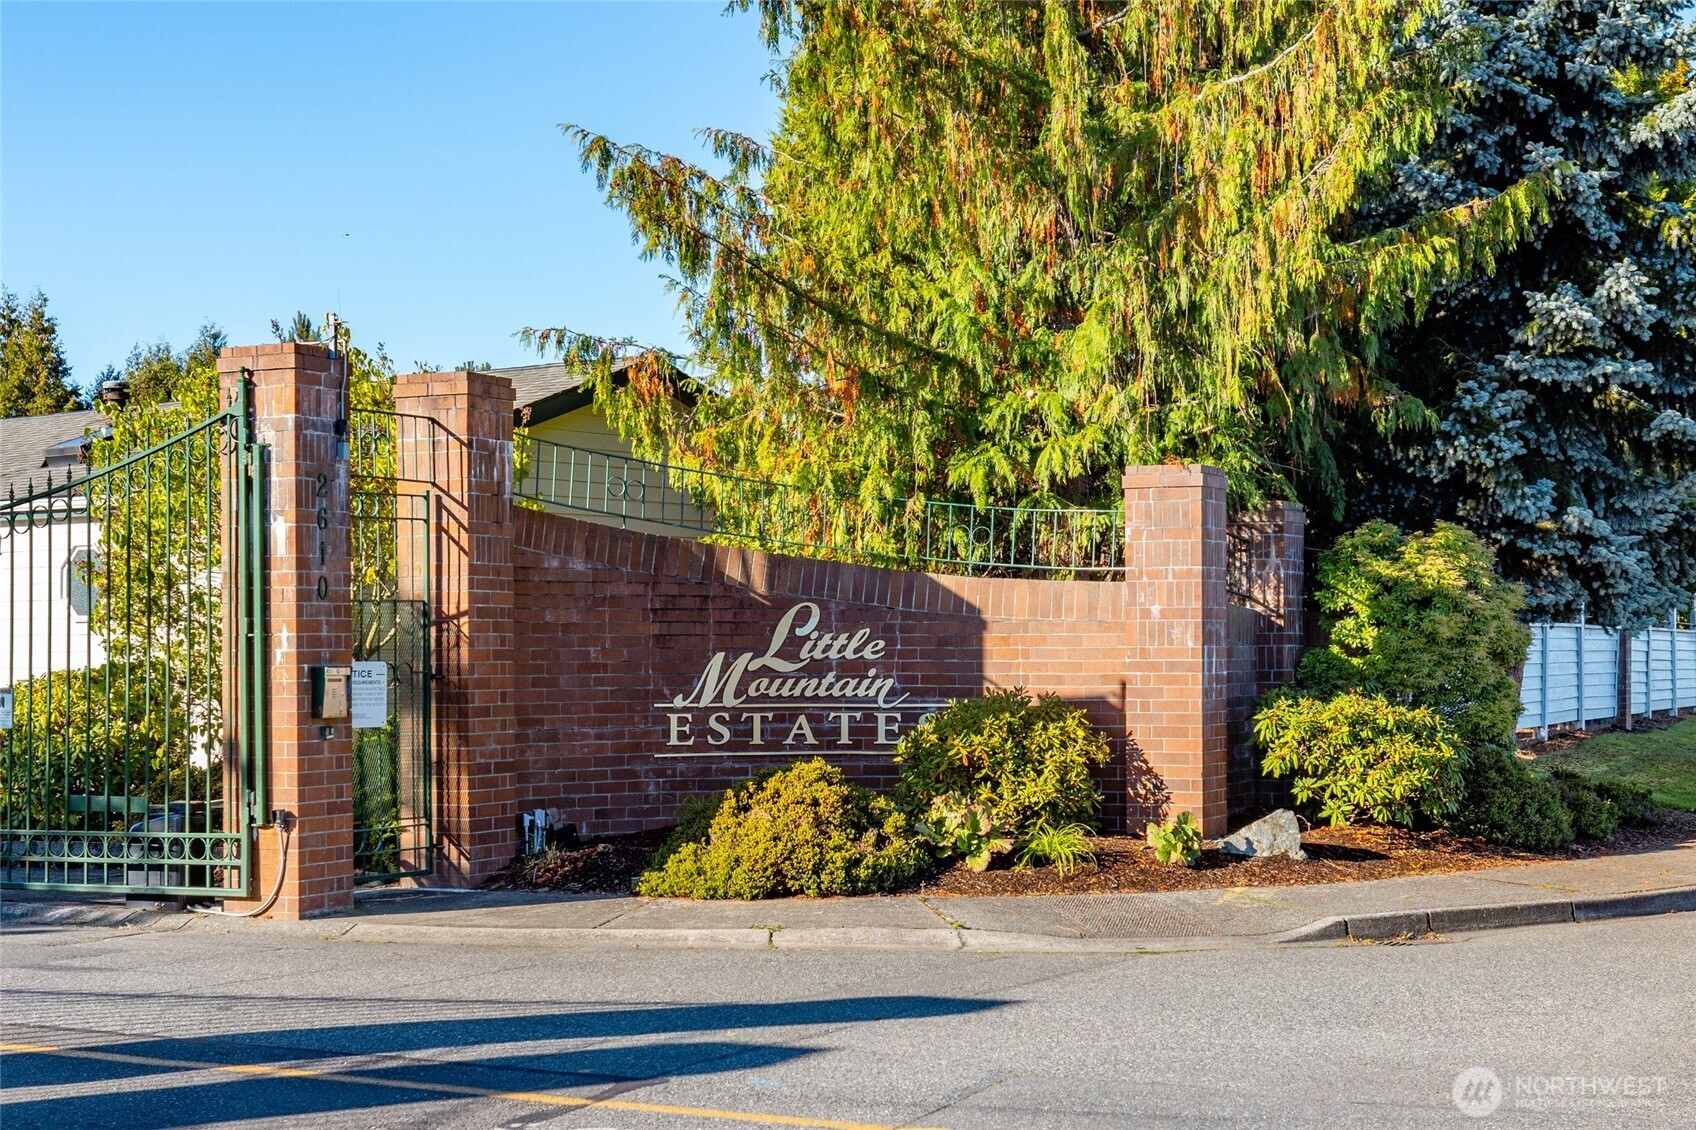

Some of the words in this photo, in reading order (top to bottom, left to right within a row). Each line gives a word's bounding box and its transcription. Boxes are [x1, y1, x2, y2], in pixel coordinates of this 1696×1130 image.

[316, 472, 328, 600] 2610
[748, 602, 886, 672] Little
[352, 670, 372, 678] TICE
[673, 651, 910, 709] Mountain
